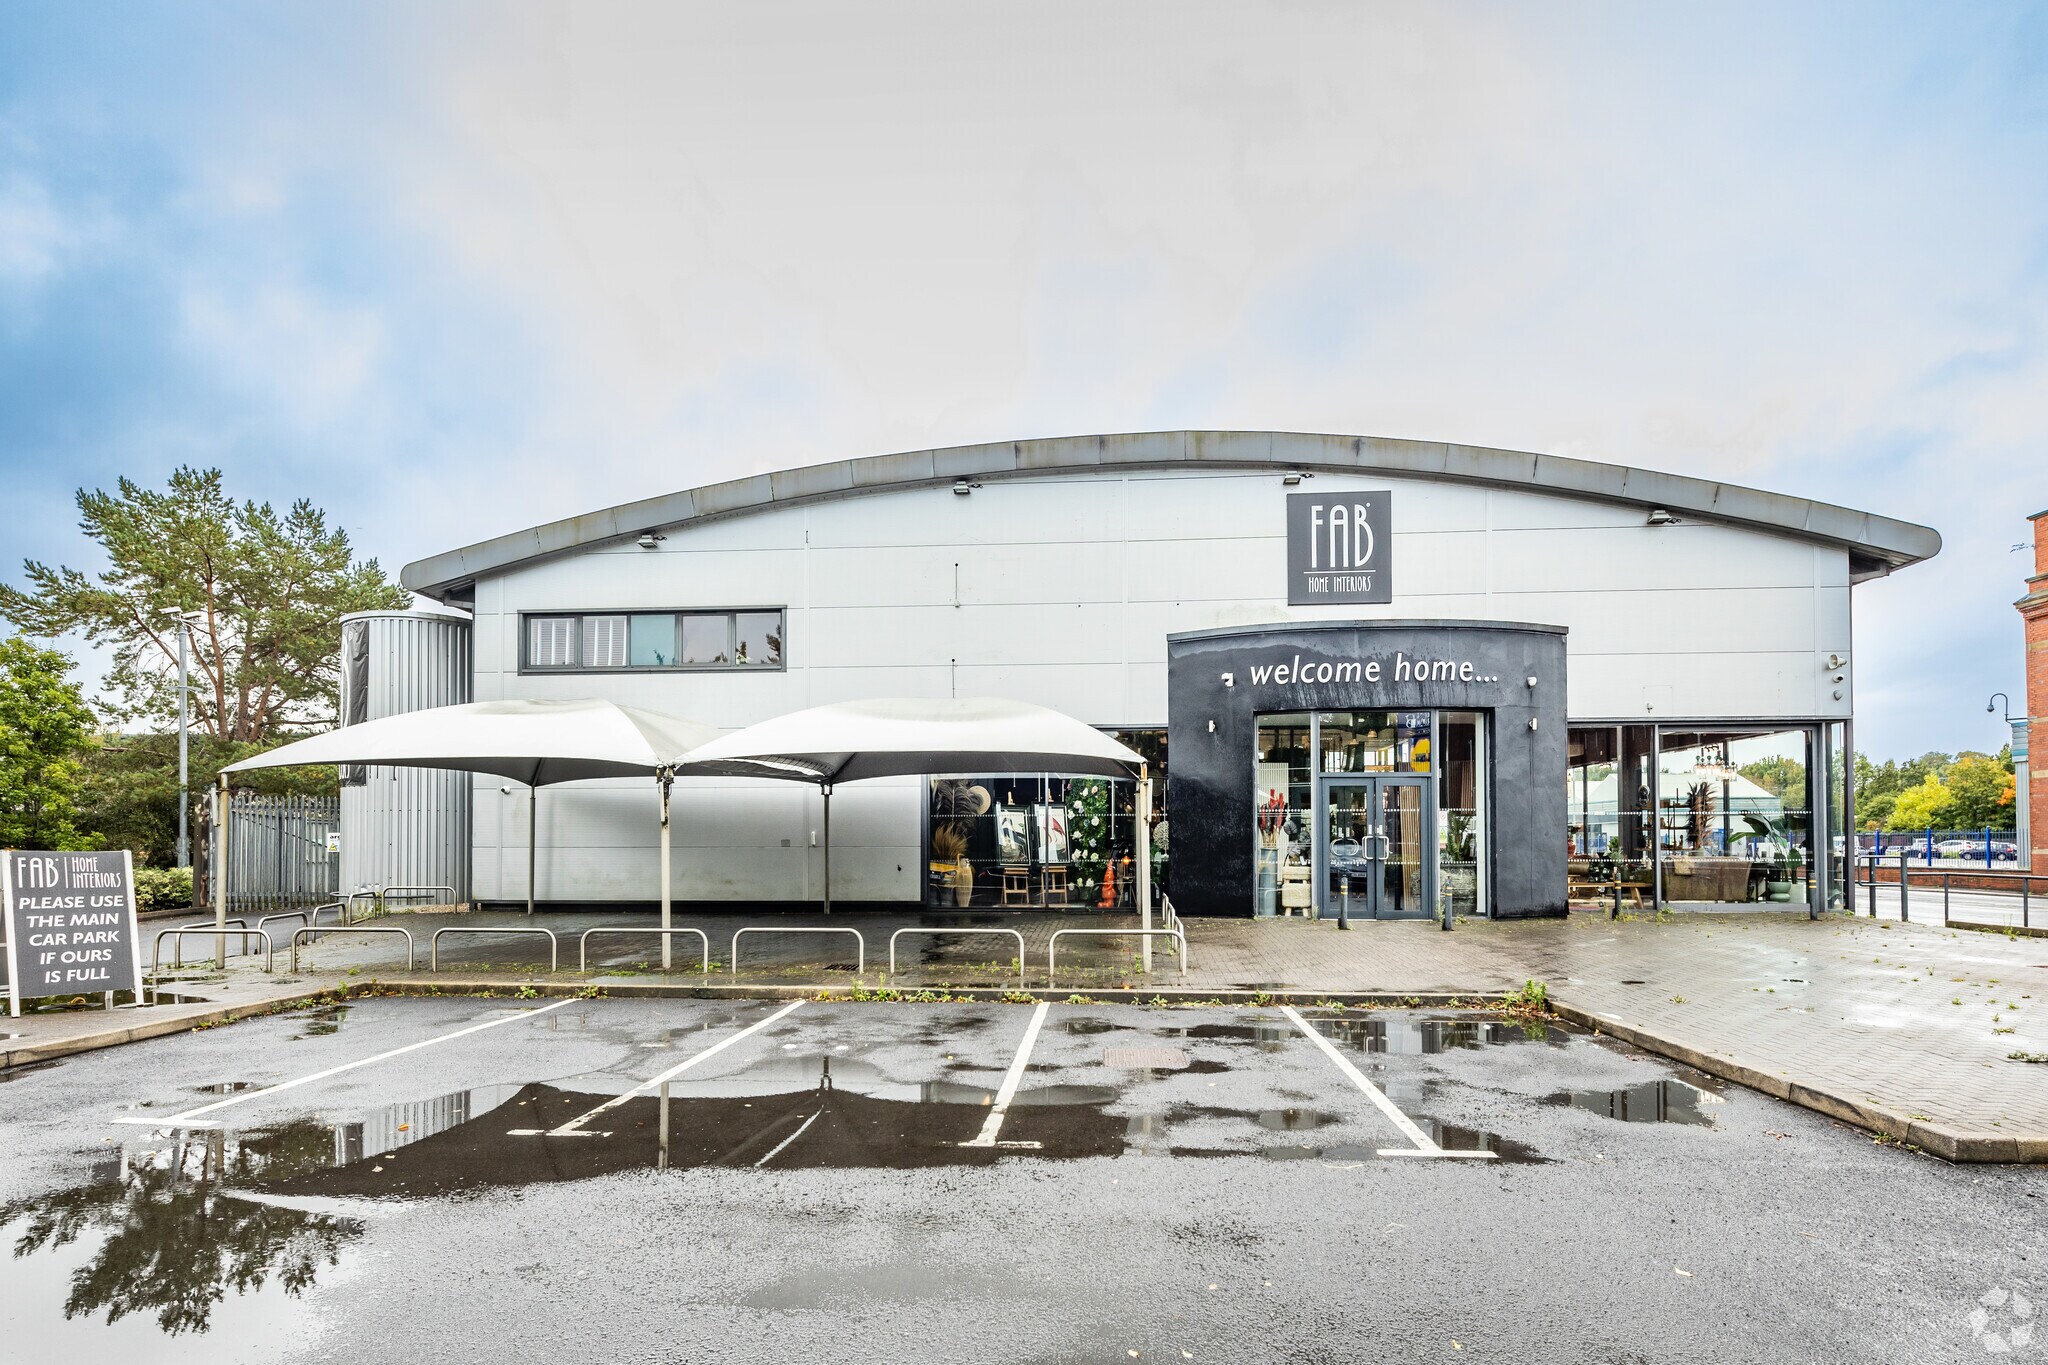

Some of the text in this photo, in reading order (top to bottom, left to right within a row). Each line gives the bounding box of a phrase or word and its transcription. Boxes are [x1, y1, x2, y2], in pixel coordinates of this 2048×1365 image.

[1311, 503, 1374, 568] FAB
[1308, 575, 1371, 593] HOME INTERIORS
[1250, 652, 1498, 686] welcome home...
[17, 857, 59, 888] FAB
[72, 857, 99, 872] HOME
[72, 872, 121, 889] INTERIORS
[19, 895, 124, 909] PLEASE USE
[26, 913, 119, 928] THE MAIN
[29, 931, 120, 946] CAR PARK
[40, 949, 112, 965] IF OURS
[45, 968, 110, 984] IS FULL
